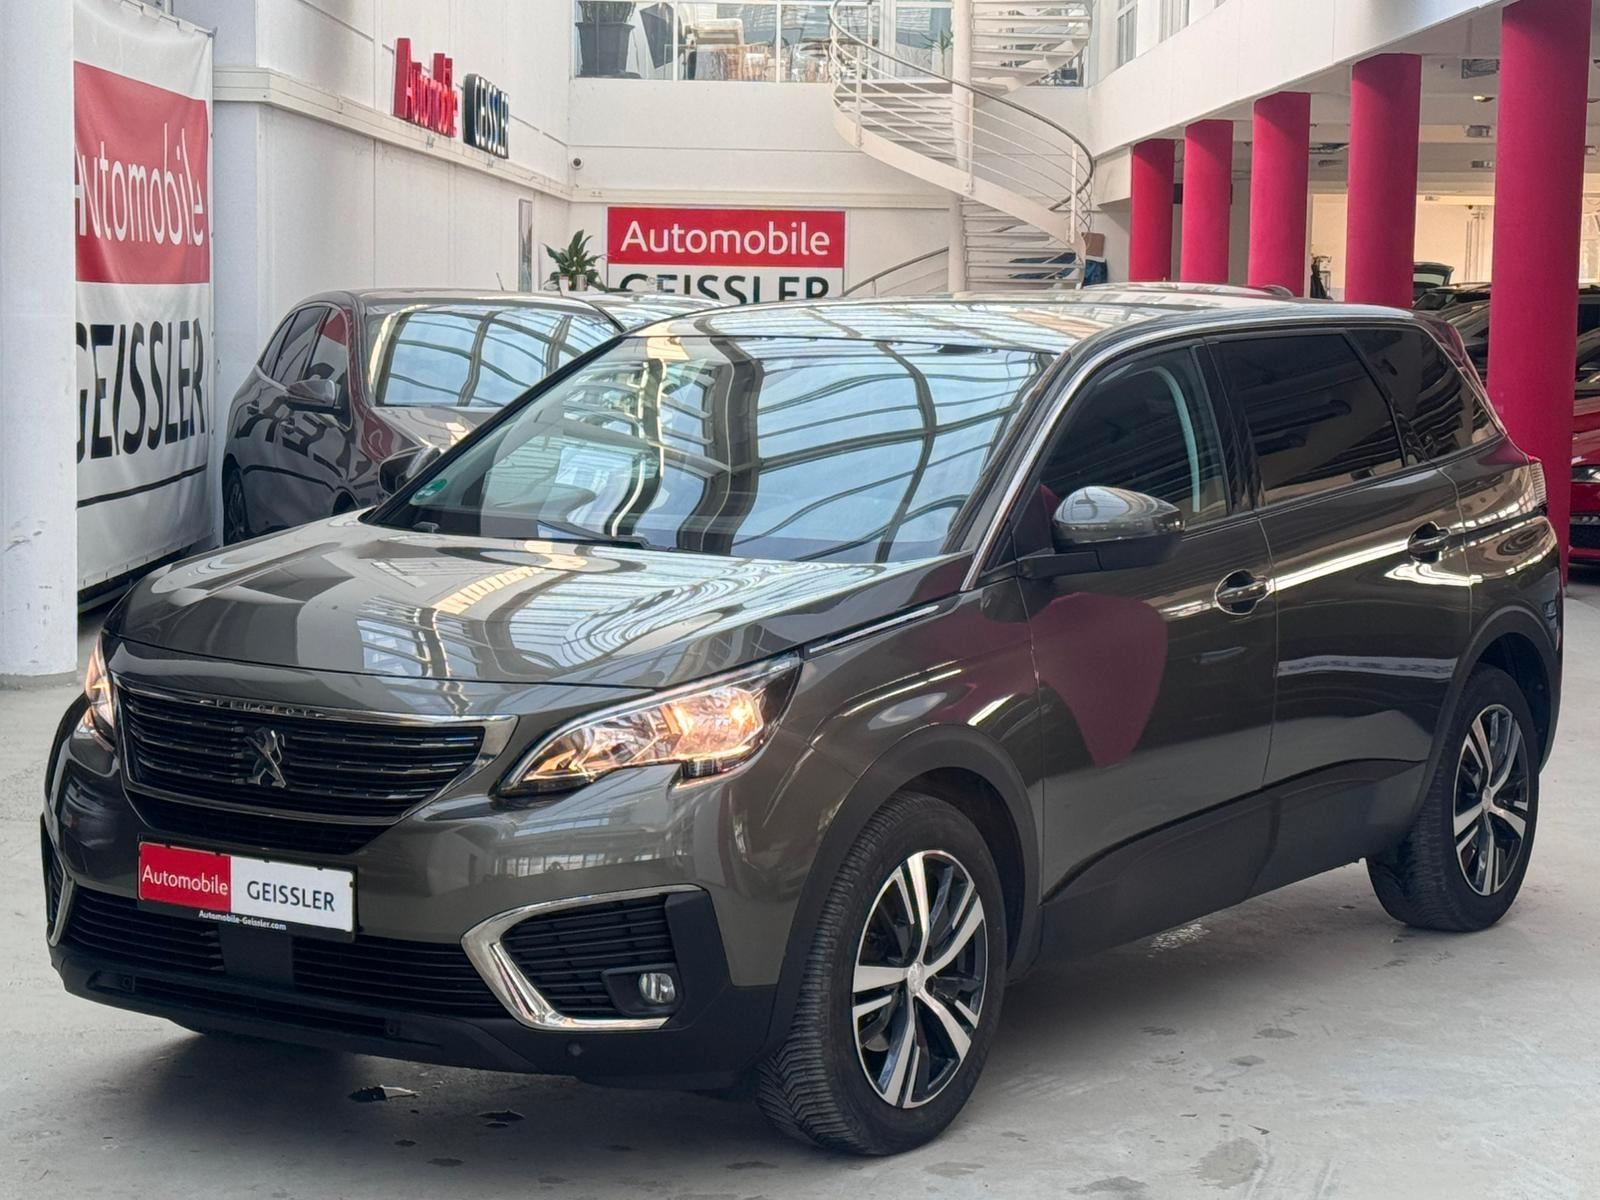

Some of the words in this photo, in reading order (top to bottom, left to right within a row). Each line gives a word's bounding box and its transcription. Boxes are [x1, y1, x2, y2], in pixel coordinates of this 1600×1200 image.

[620, 220, 831, 256] Automobile
[141, 865, 229, 897] Automobile
[246, 880, 336, 912] GEISSLER
[198, 909, 287, 931] Automobile-Geissler.com
